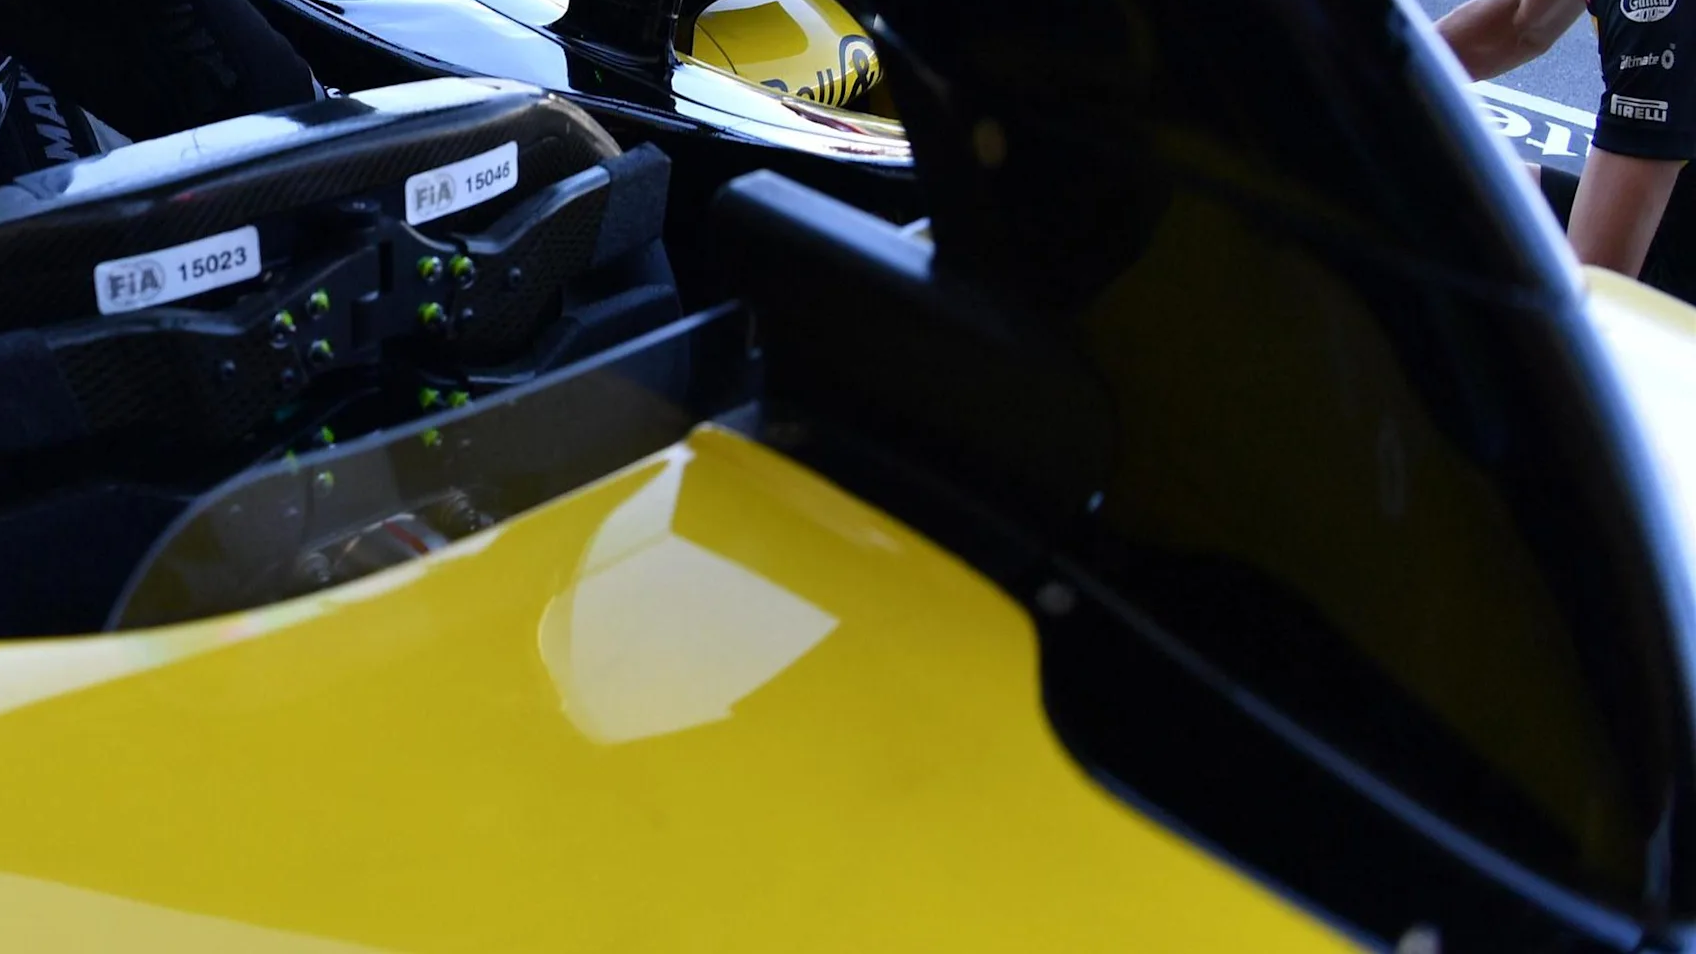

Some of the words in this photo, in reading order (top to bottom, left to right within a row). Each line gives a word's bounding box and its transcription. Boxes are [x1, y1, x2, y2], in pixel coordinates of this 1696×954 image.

[1610, 93, 1669, 123] PIRELLI
[465, 160, 510, 193] 15046
[178, 246, 247, 281] 15023
